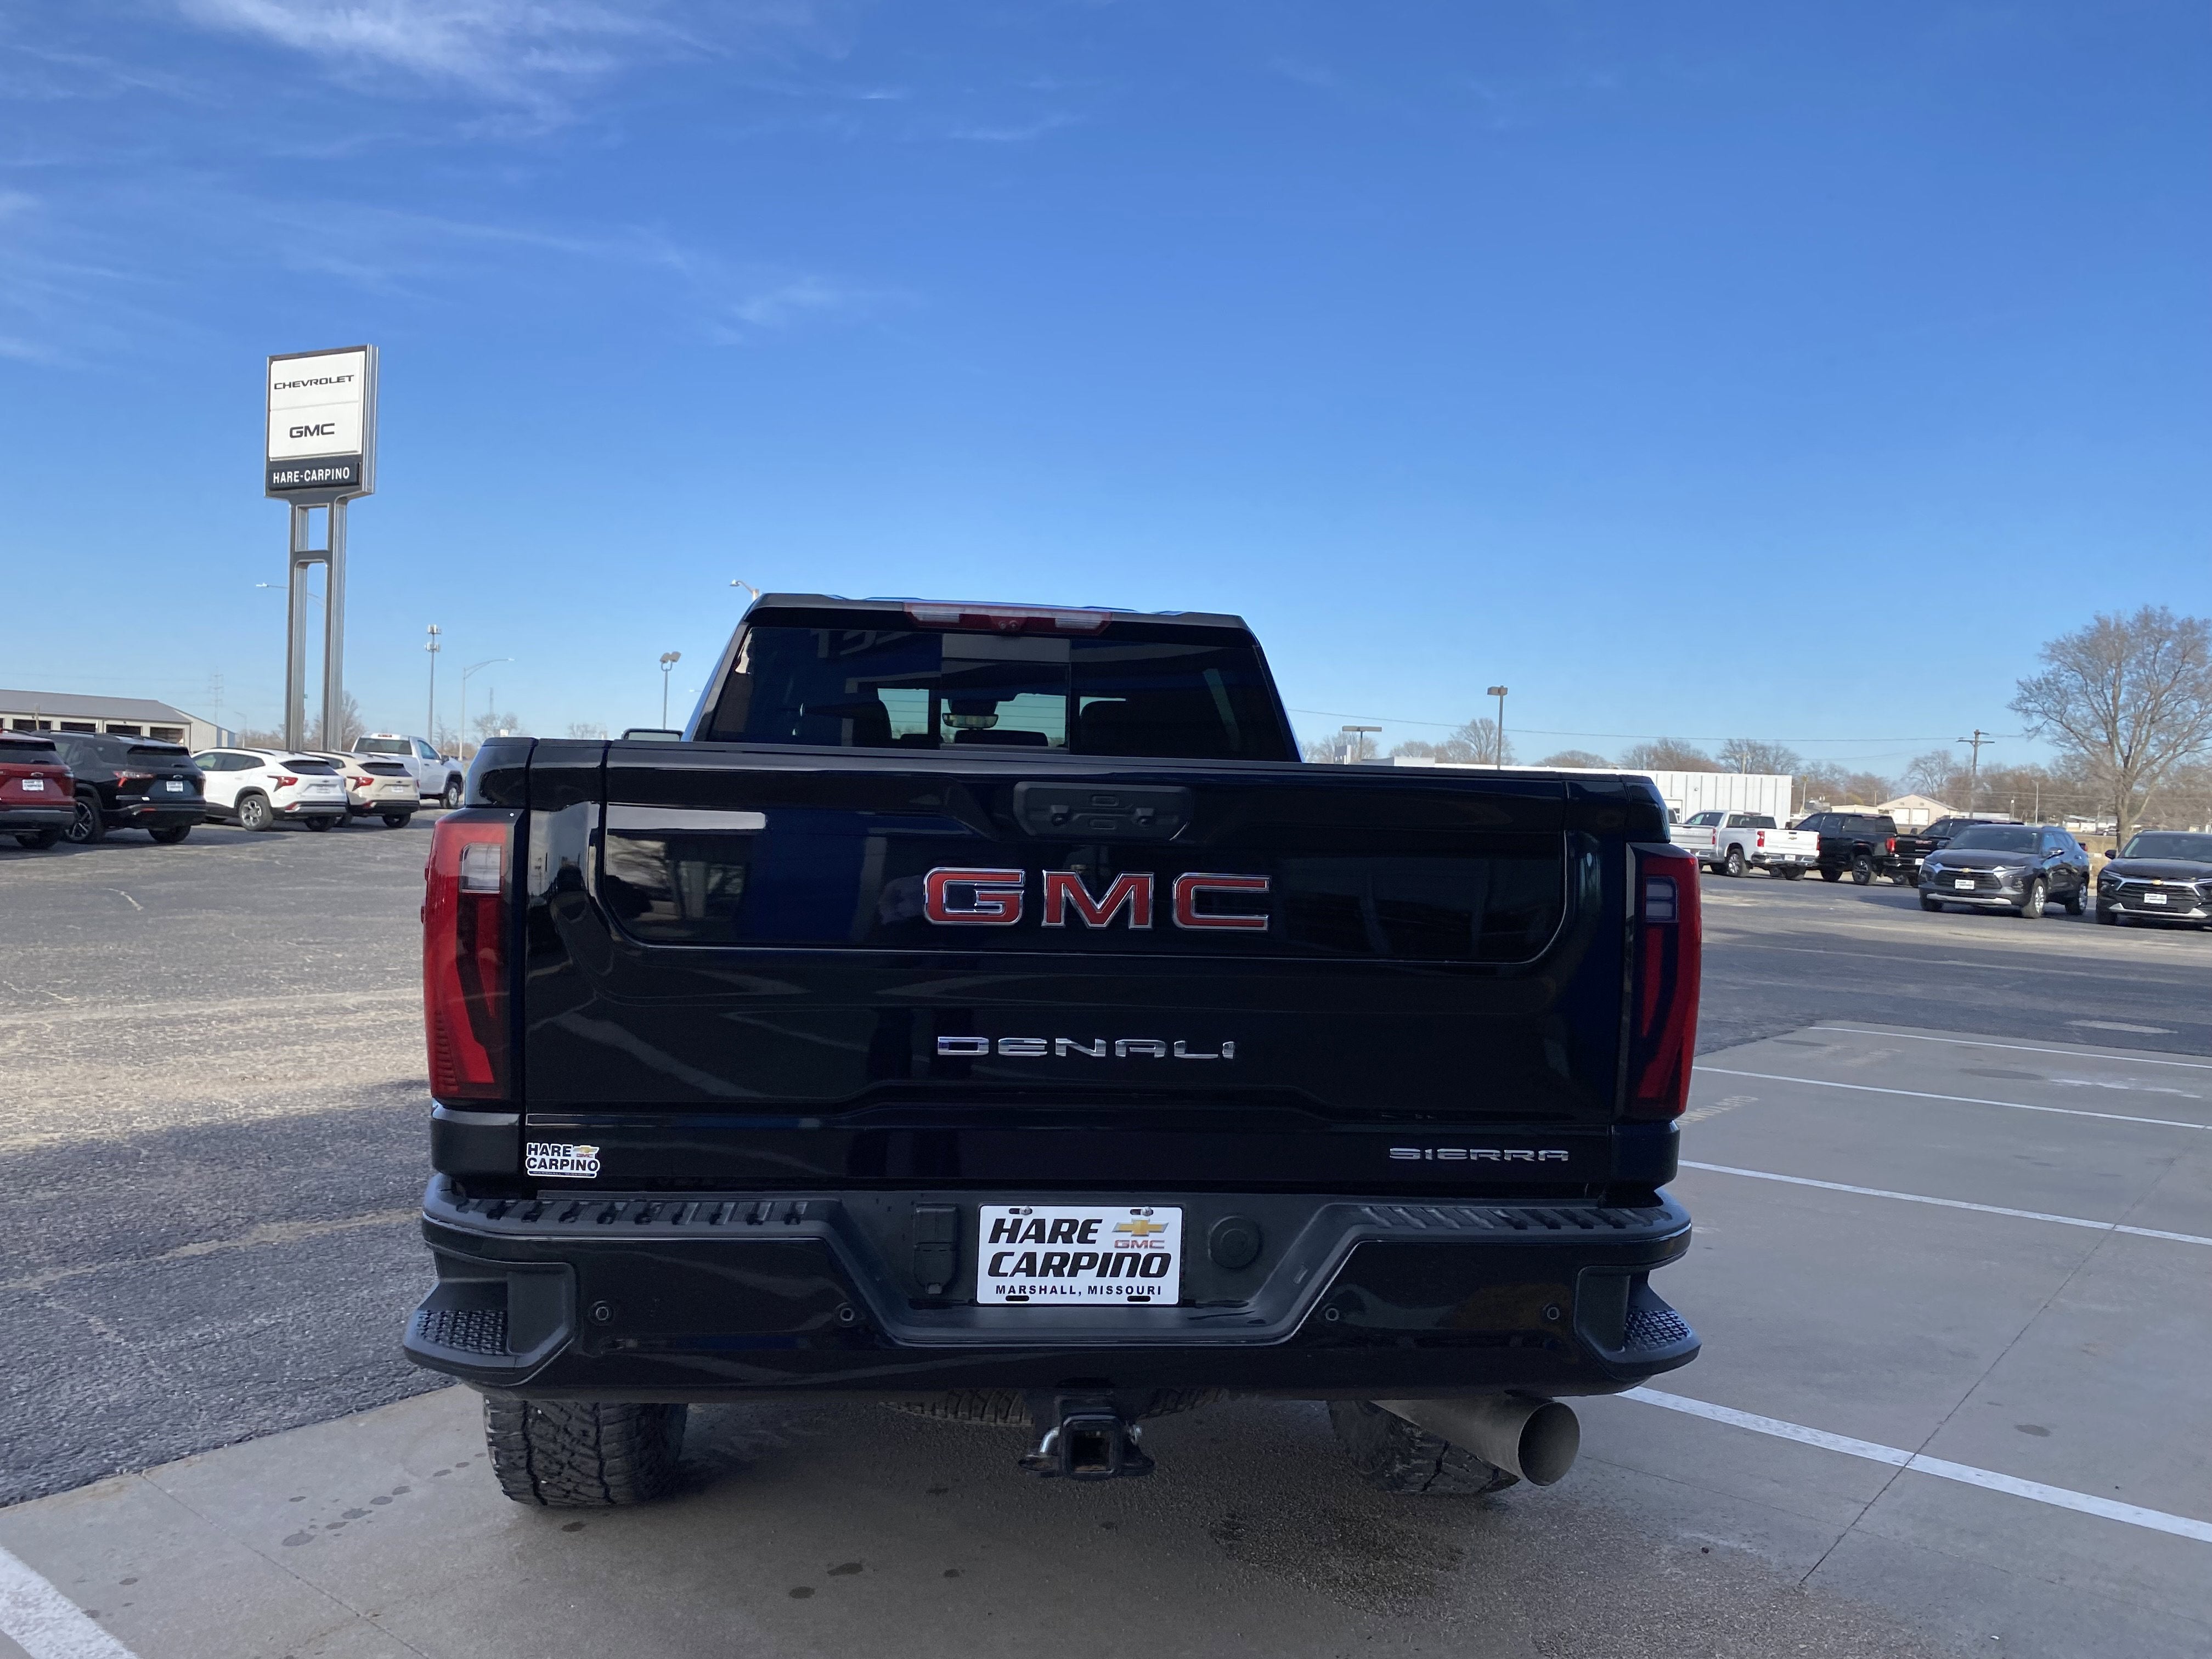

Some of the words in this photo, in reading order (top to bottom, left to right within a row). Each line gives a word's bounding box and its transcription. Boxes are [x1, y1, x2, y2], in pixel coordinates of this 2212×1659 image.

[274, 375, 354, 390] CHEVROLET
[289, 423, 335, 438] GMC
[273, 467, 350, 483] HARE-CARPINO
[923, 867, 1272, 931] GMC
[937, 1036, 1236, 1059] DENALI
[527, 1144, 572, 1157] HARE
[1389, 1148, 1568, 1161] SIERRA
[527, 1157, 599, 1171] CARPINO
[988, 1218, 1103, 1244] HARE
[1114, 1239, 1165, 1249] GMC
[988, 1251, 1172, 1278] CARPINO
[995, 1285, 1082, 1296] MARSHALL,
[1087, 1285, 1162, 1295] MISSOURI
